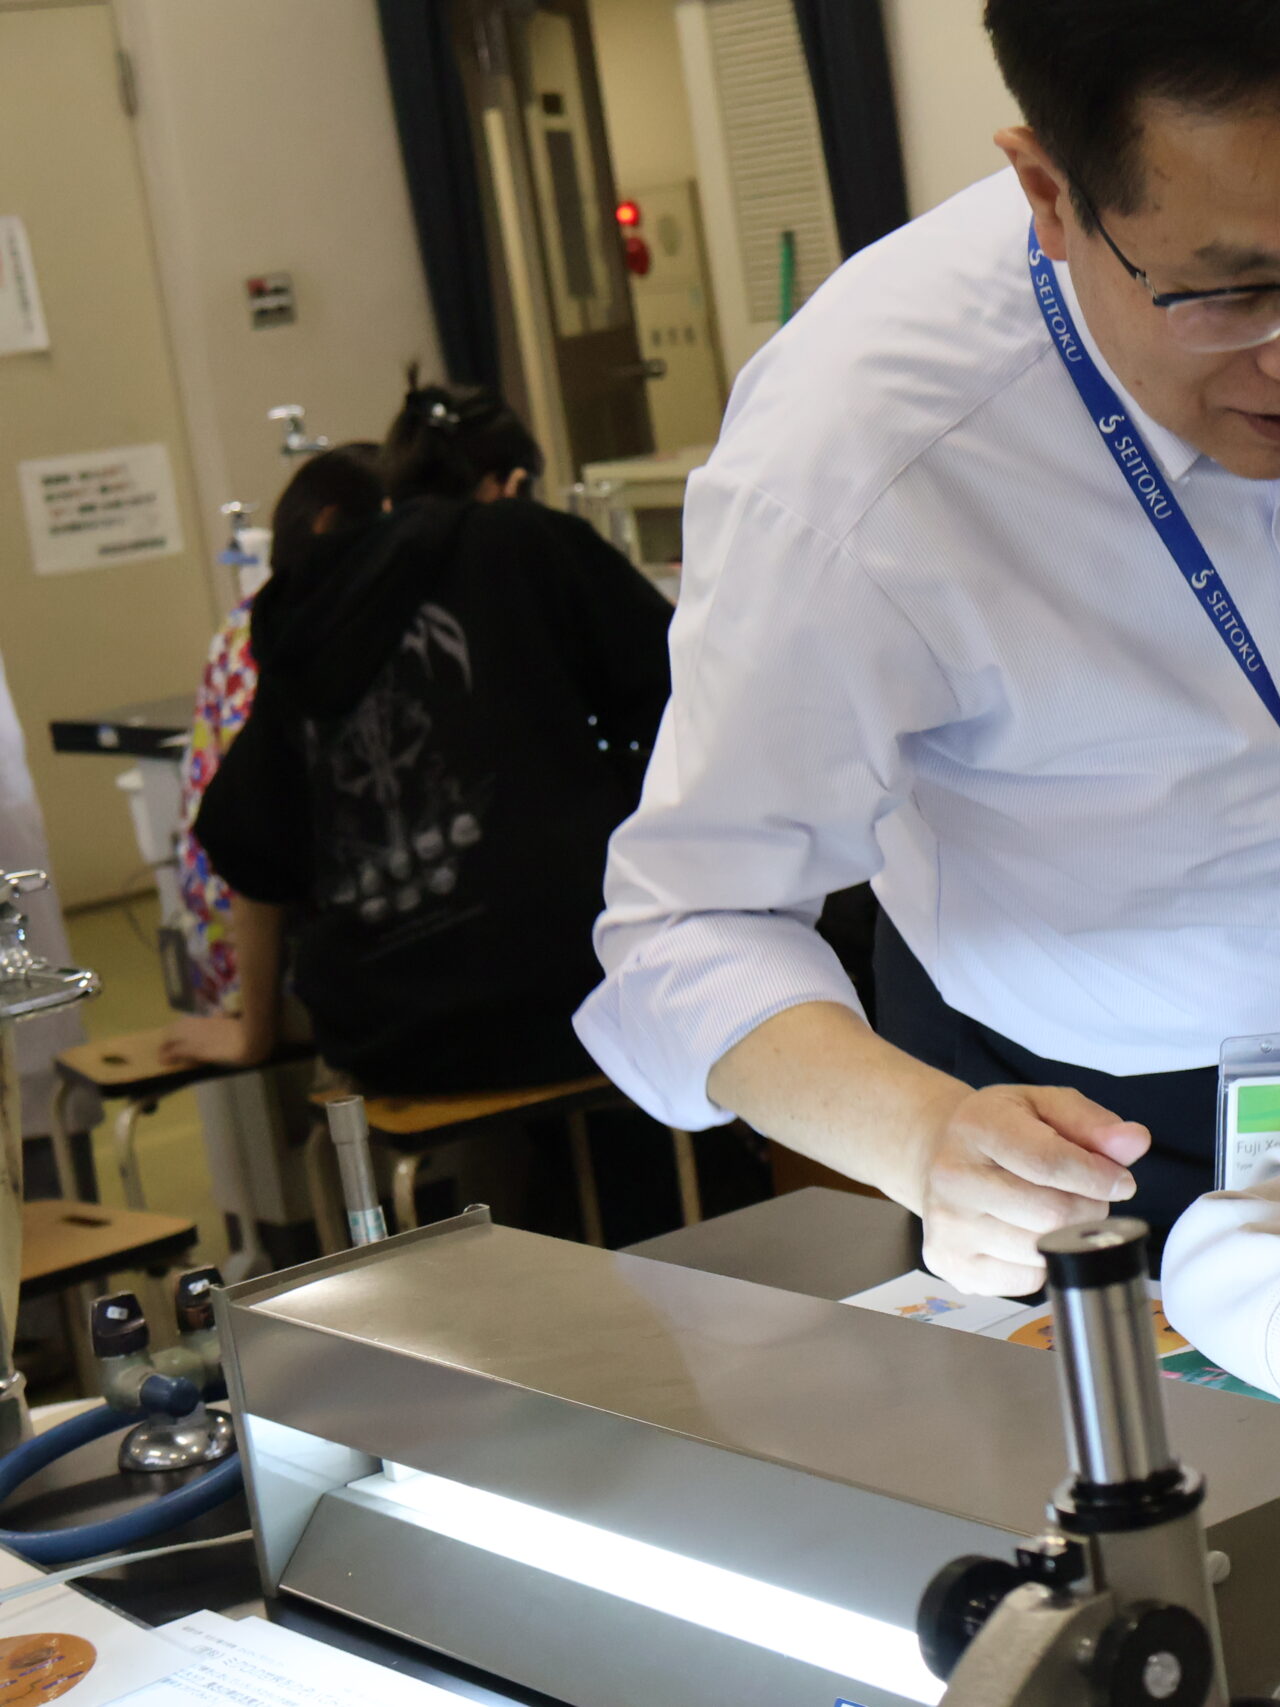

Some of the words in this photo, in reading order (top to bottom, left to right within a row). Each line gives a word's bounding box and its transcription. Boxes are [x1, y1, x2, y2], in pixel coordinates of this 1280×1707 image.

[1035, 273, 1083, 363] SEITOKU
[1114, 435, 1172, 521] SEITOKU
[1206, 590, 1261, 672] SEITOKU
[1236, 1140, 1261, 1157] Fuji
